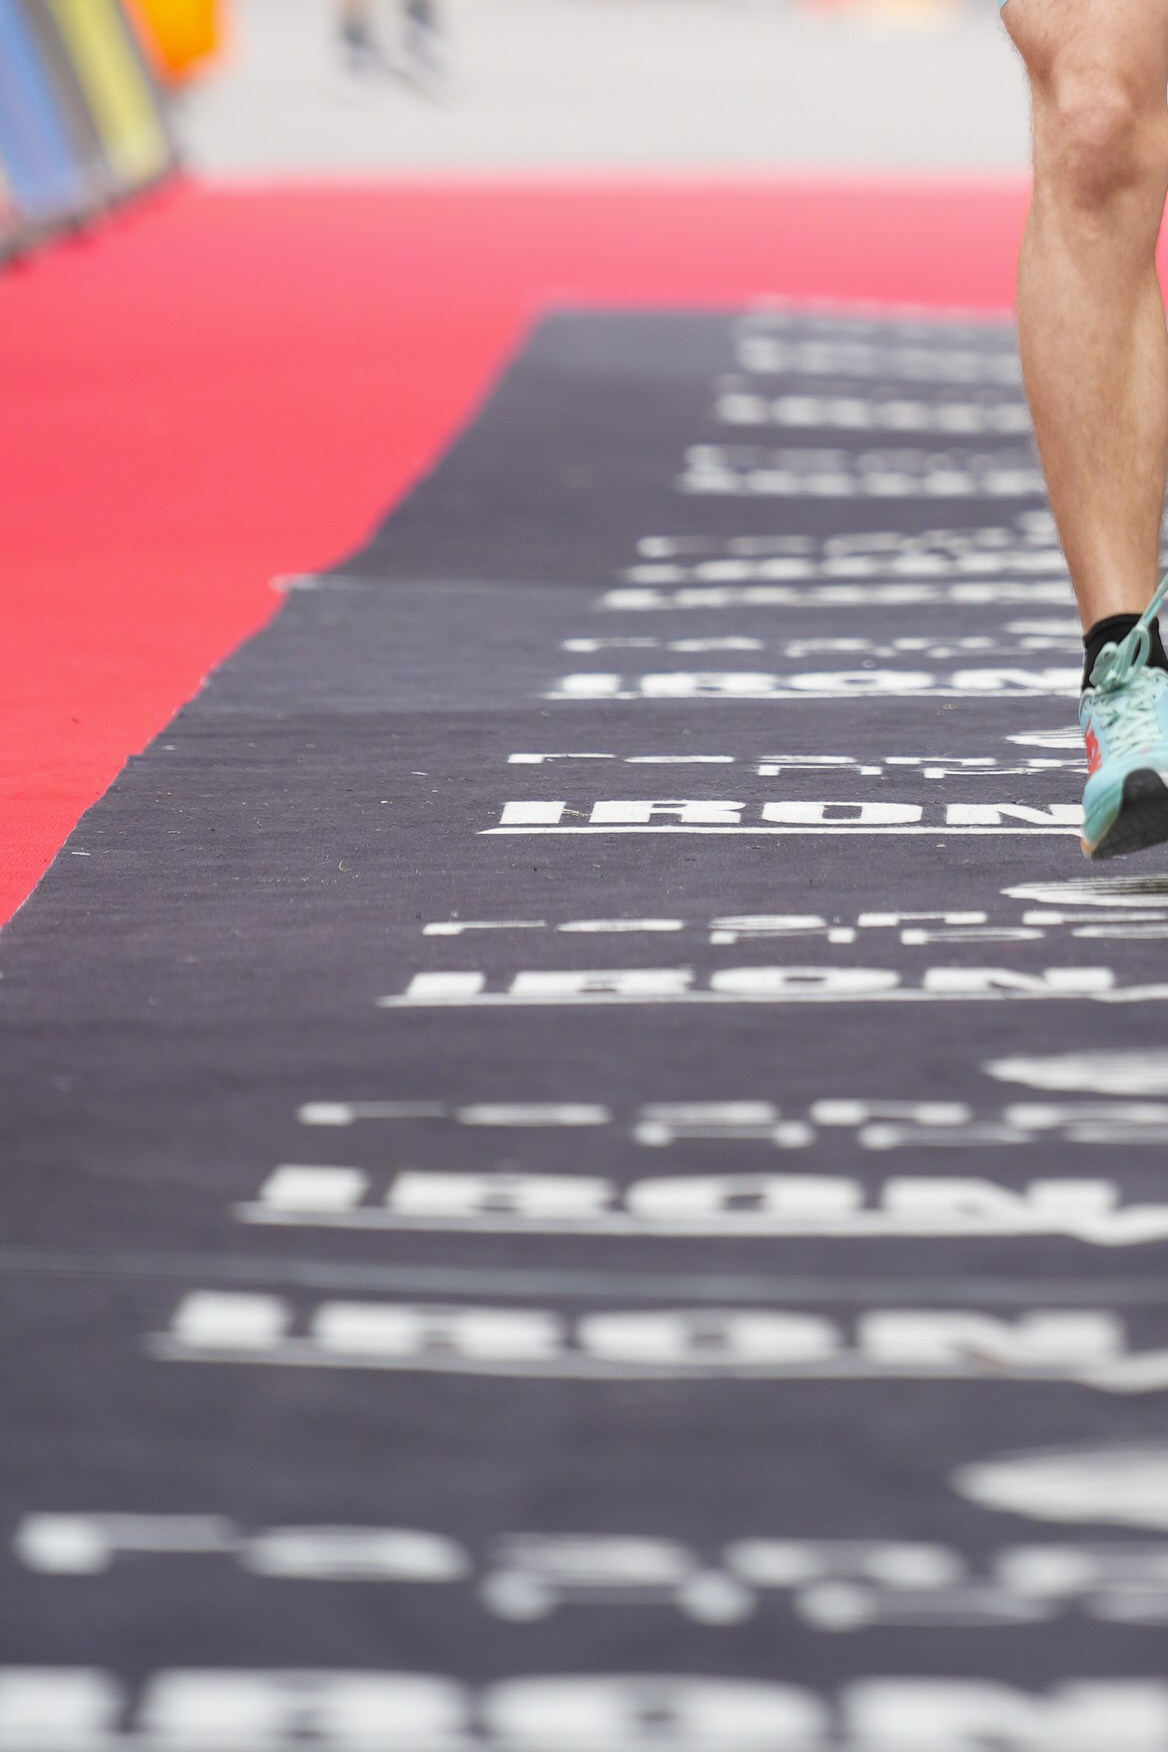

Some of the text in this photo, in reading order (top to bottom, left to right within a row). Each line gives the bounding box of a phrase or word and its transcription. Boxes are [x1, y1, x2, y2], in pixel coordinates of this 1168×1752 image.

[499, 799, 1086, 825] IRON
[406, 965, 1115, 997] IRON
[260, 1163, 1118, 1218] IRON
